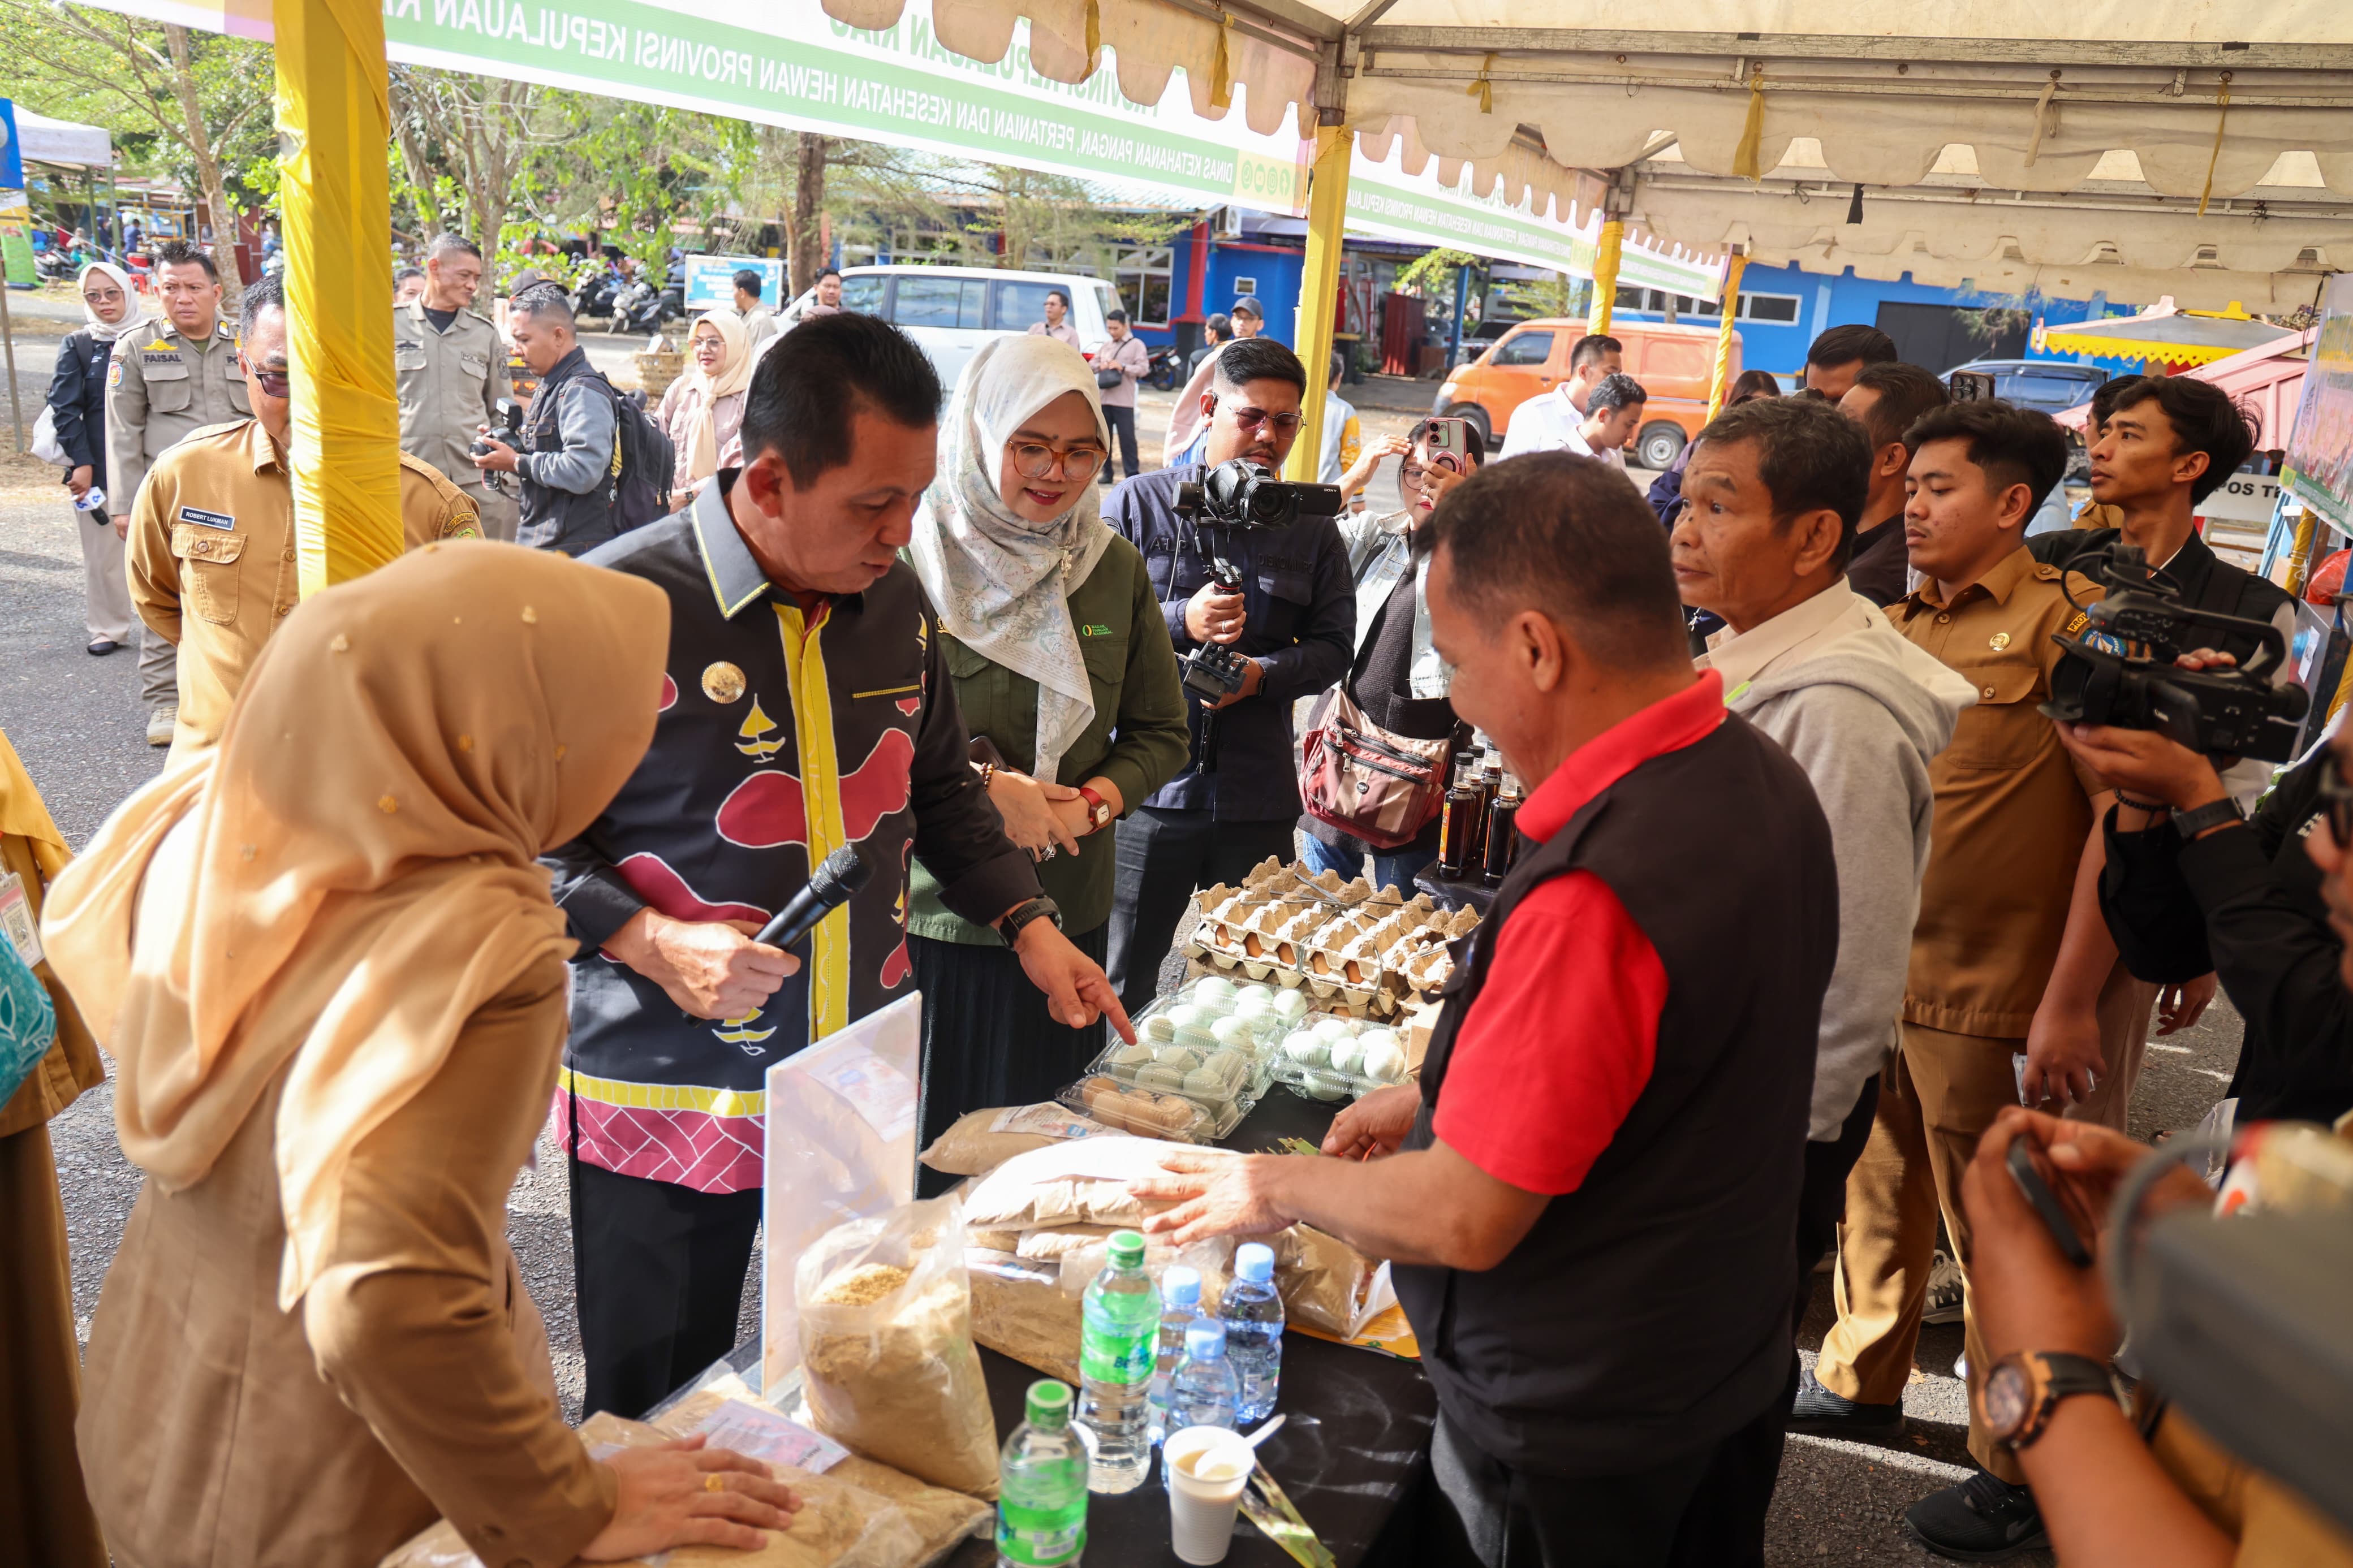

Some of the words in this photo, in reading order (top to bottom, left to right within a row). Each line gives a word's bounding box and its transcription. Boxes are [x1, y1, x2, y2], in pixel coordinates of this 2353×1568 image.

[144, 354, 182, 363] FAISAL
[186, 512, 206, 520] ROBERT
[207, 516, 228, 525] LUKMAN
